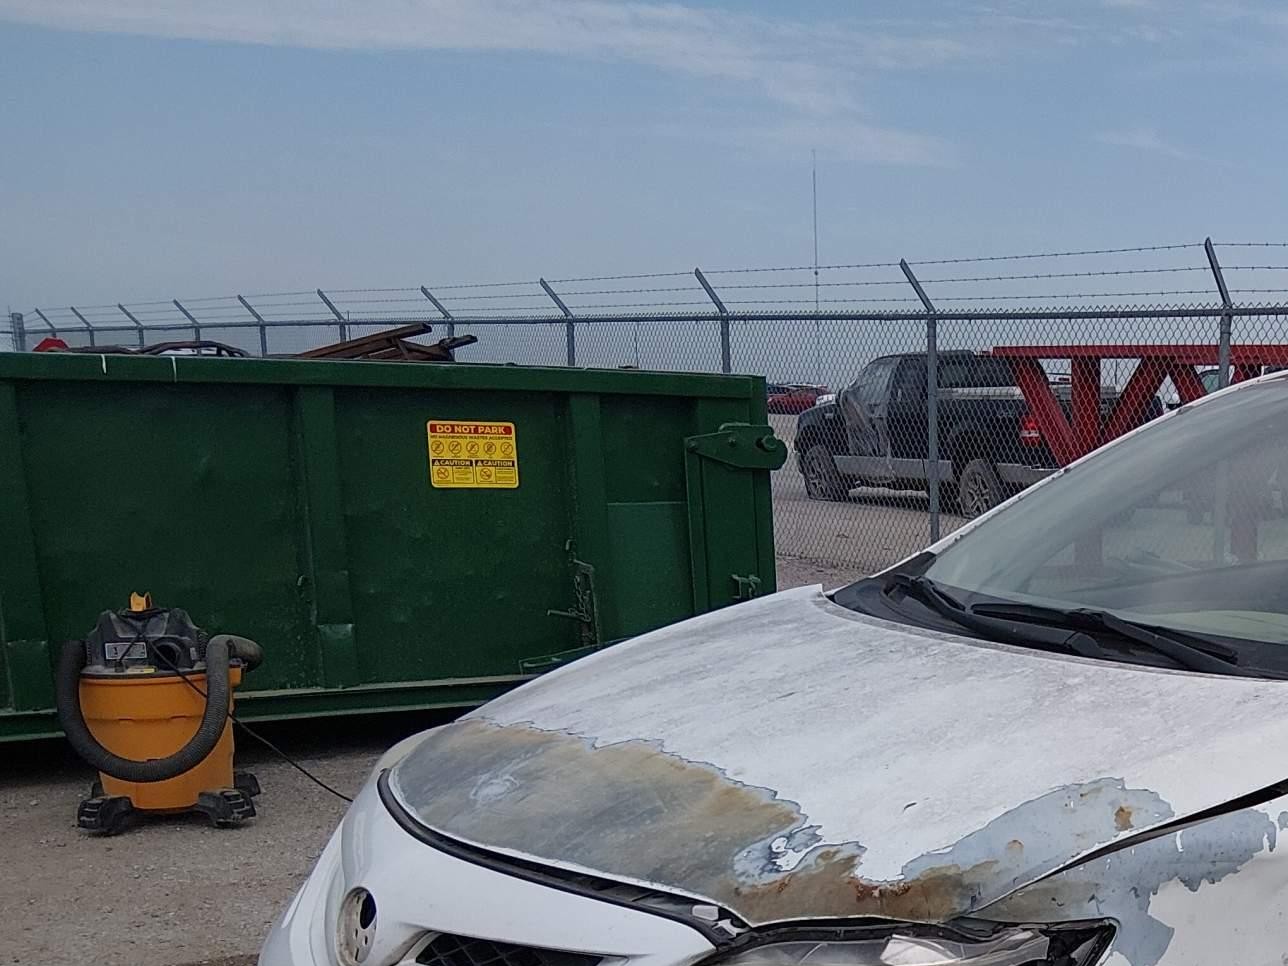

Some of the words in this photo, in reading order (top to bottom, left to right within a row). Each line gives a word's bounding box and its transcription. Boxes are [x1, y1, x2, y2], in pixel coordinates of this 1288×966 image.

[436, 425, 452, 433] DO
[454, 426, 476, 434] NOT
[478, 426, 506, 434] PARK
